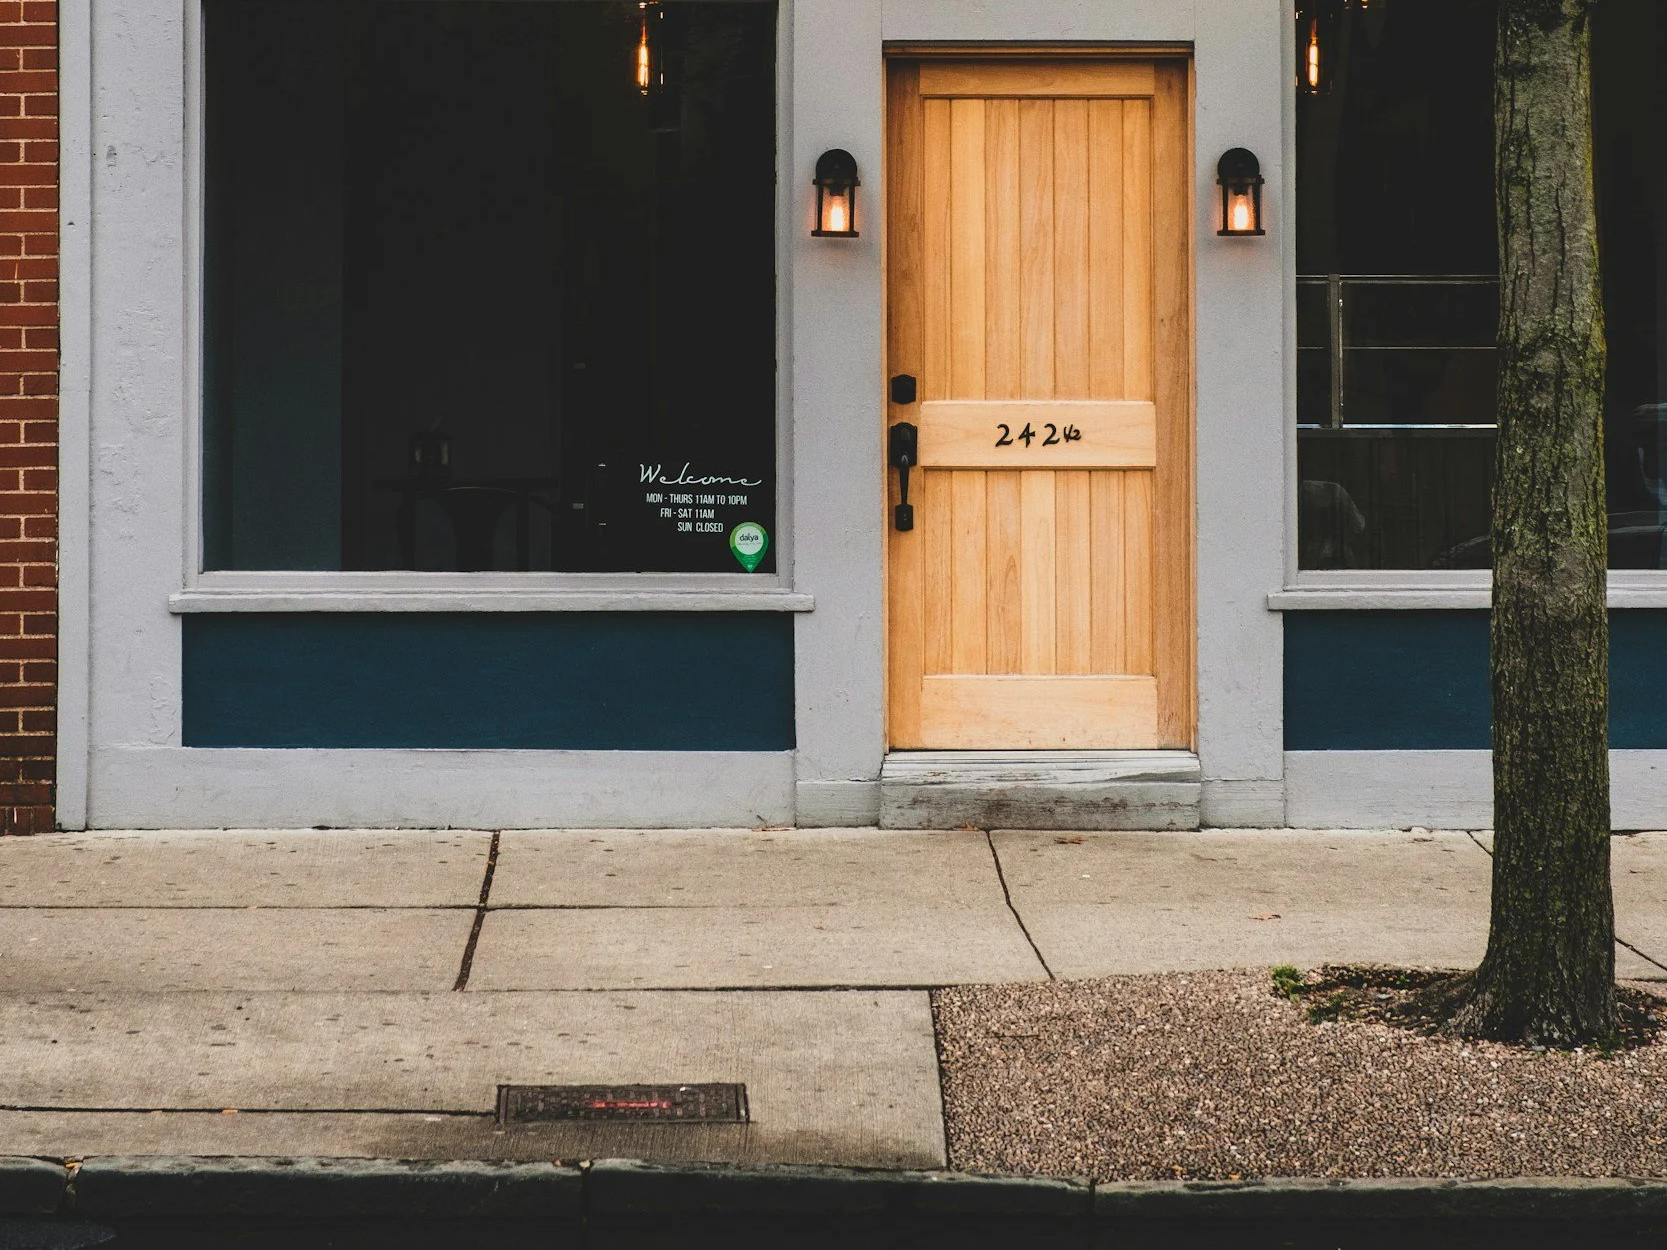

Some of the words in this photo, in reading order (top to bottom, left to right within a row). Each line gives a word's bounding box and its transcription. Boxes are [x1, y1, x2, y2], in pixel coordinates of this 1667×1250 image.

[639, 461, 762, 487] Welcome
[646, 493, 663, 503] MON
[669, 493, 693, 504] THURS
[695, 494, 715, 505] 11AM
[716, 494, 726, 505] TO
[728, 495, 748, 506] 10PM
[660, 507, 672, 518] FRI
[678, 508, 693, 519] SAT
[695, 508, 715, 519] 11AM
[677, 521, 693, 532] SUN
[695, 522, 724, 533] CLOSED
